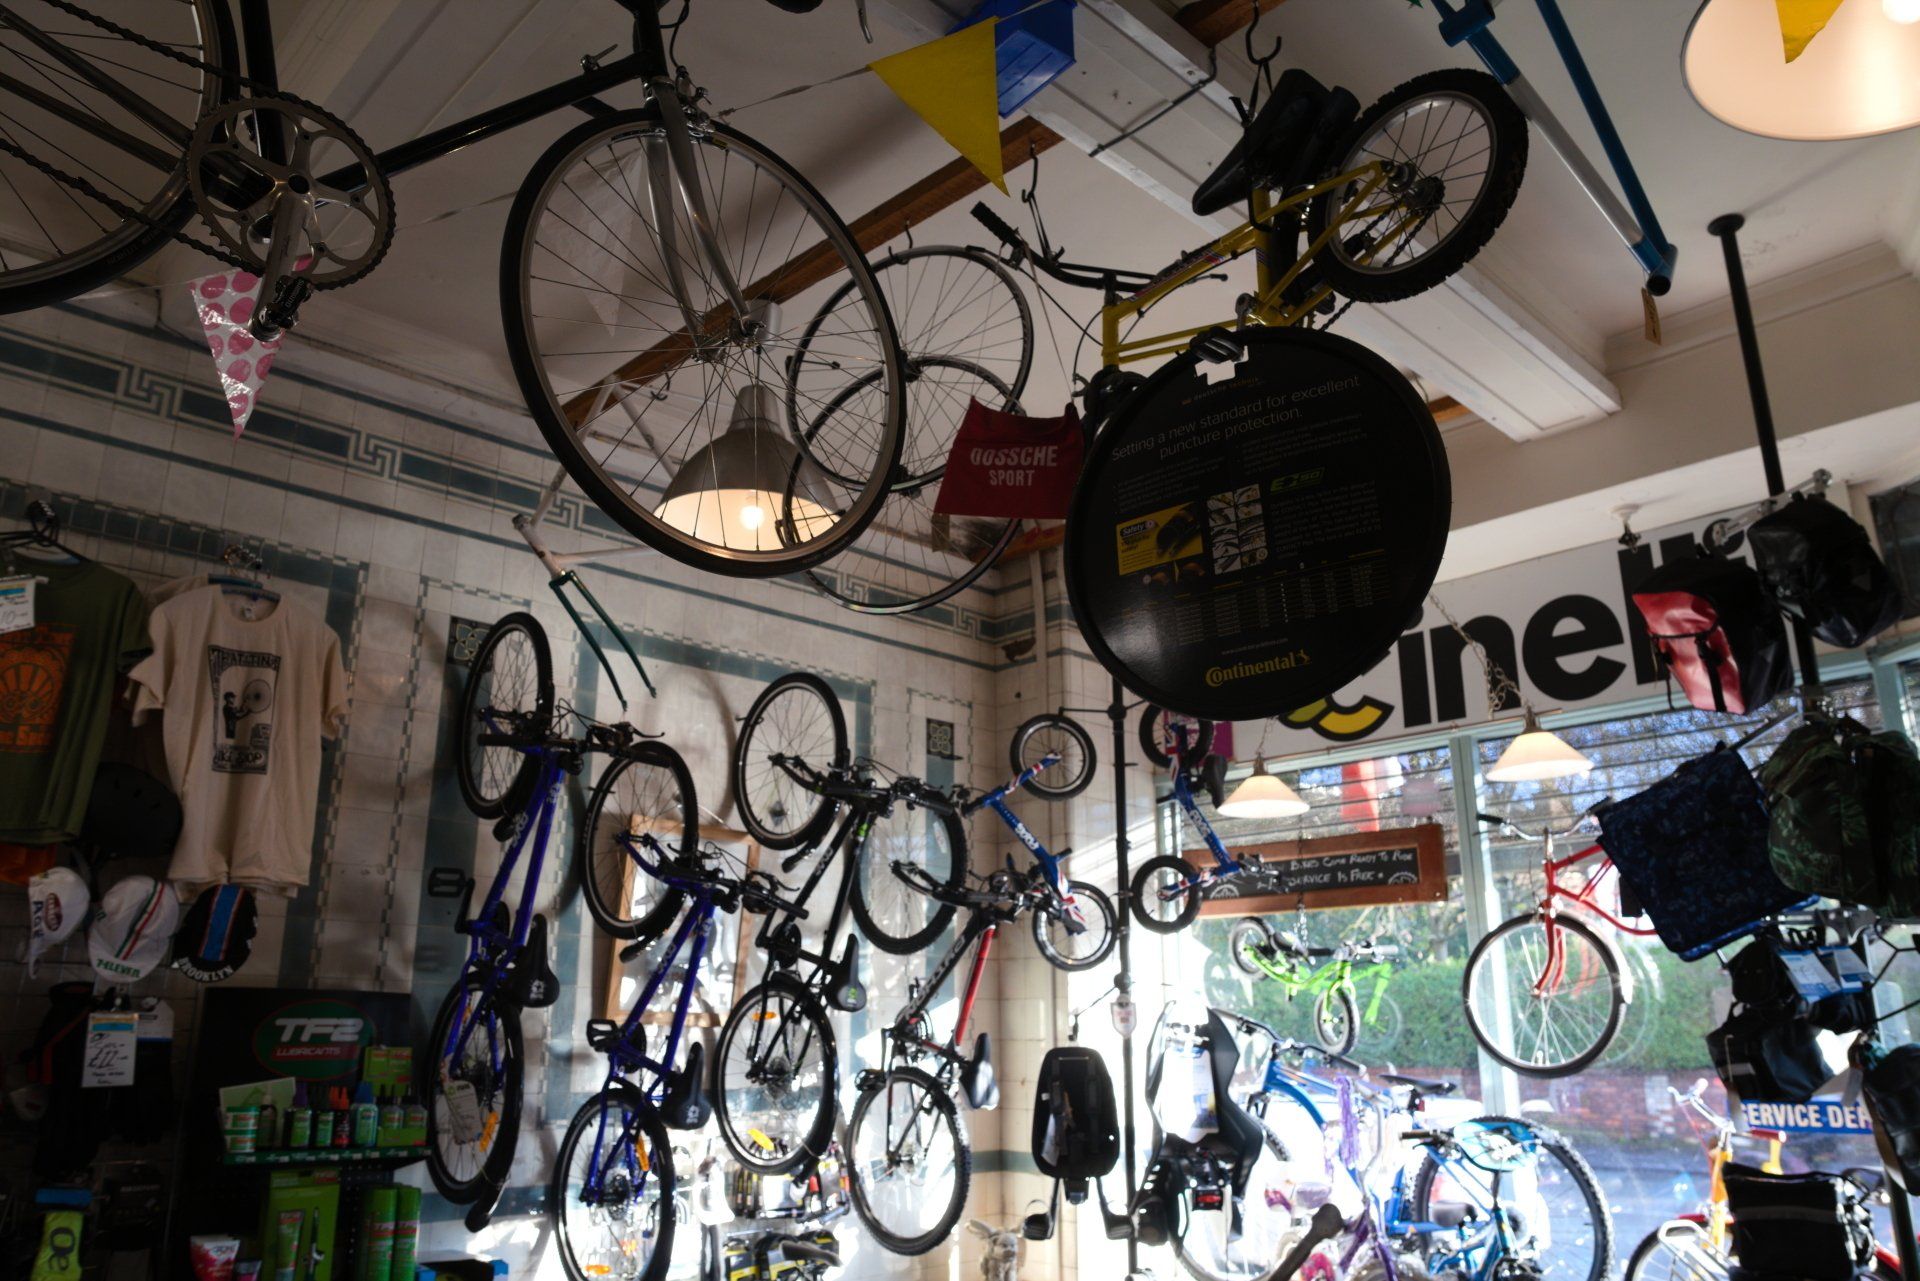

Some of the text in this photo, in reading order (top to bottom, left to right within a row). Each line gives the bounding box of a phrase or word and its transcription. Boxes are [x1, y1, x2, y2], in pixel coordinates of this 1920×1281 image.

[1111, 375, 1361, 462] Setting a new standard for excellent
[1160, 429, 1222, 460] puncture
[1224, 406, 1304, 440] protection.
[989, 470, 1035, 487] SPORT
[1279, 518, 1747, 741] cinel
[1204, 651, 1296, 688] Continental
[1288, 873, 1331, 886] SERVICE
[1350, 868, 1376, 882] FREE
[179, 957, 234, 983] BROOKLYN
[274, 1016, 364, 1044] TF2
[275, 1045, 342, 1058] LUBRICANTS
[1741, 1102, 1824, 1128] SERVICE
